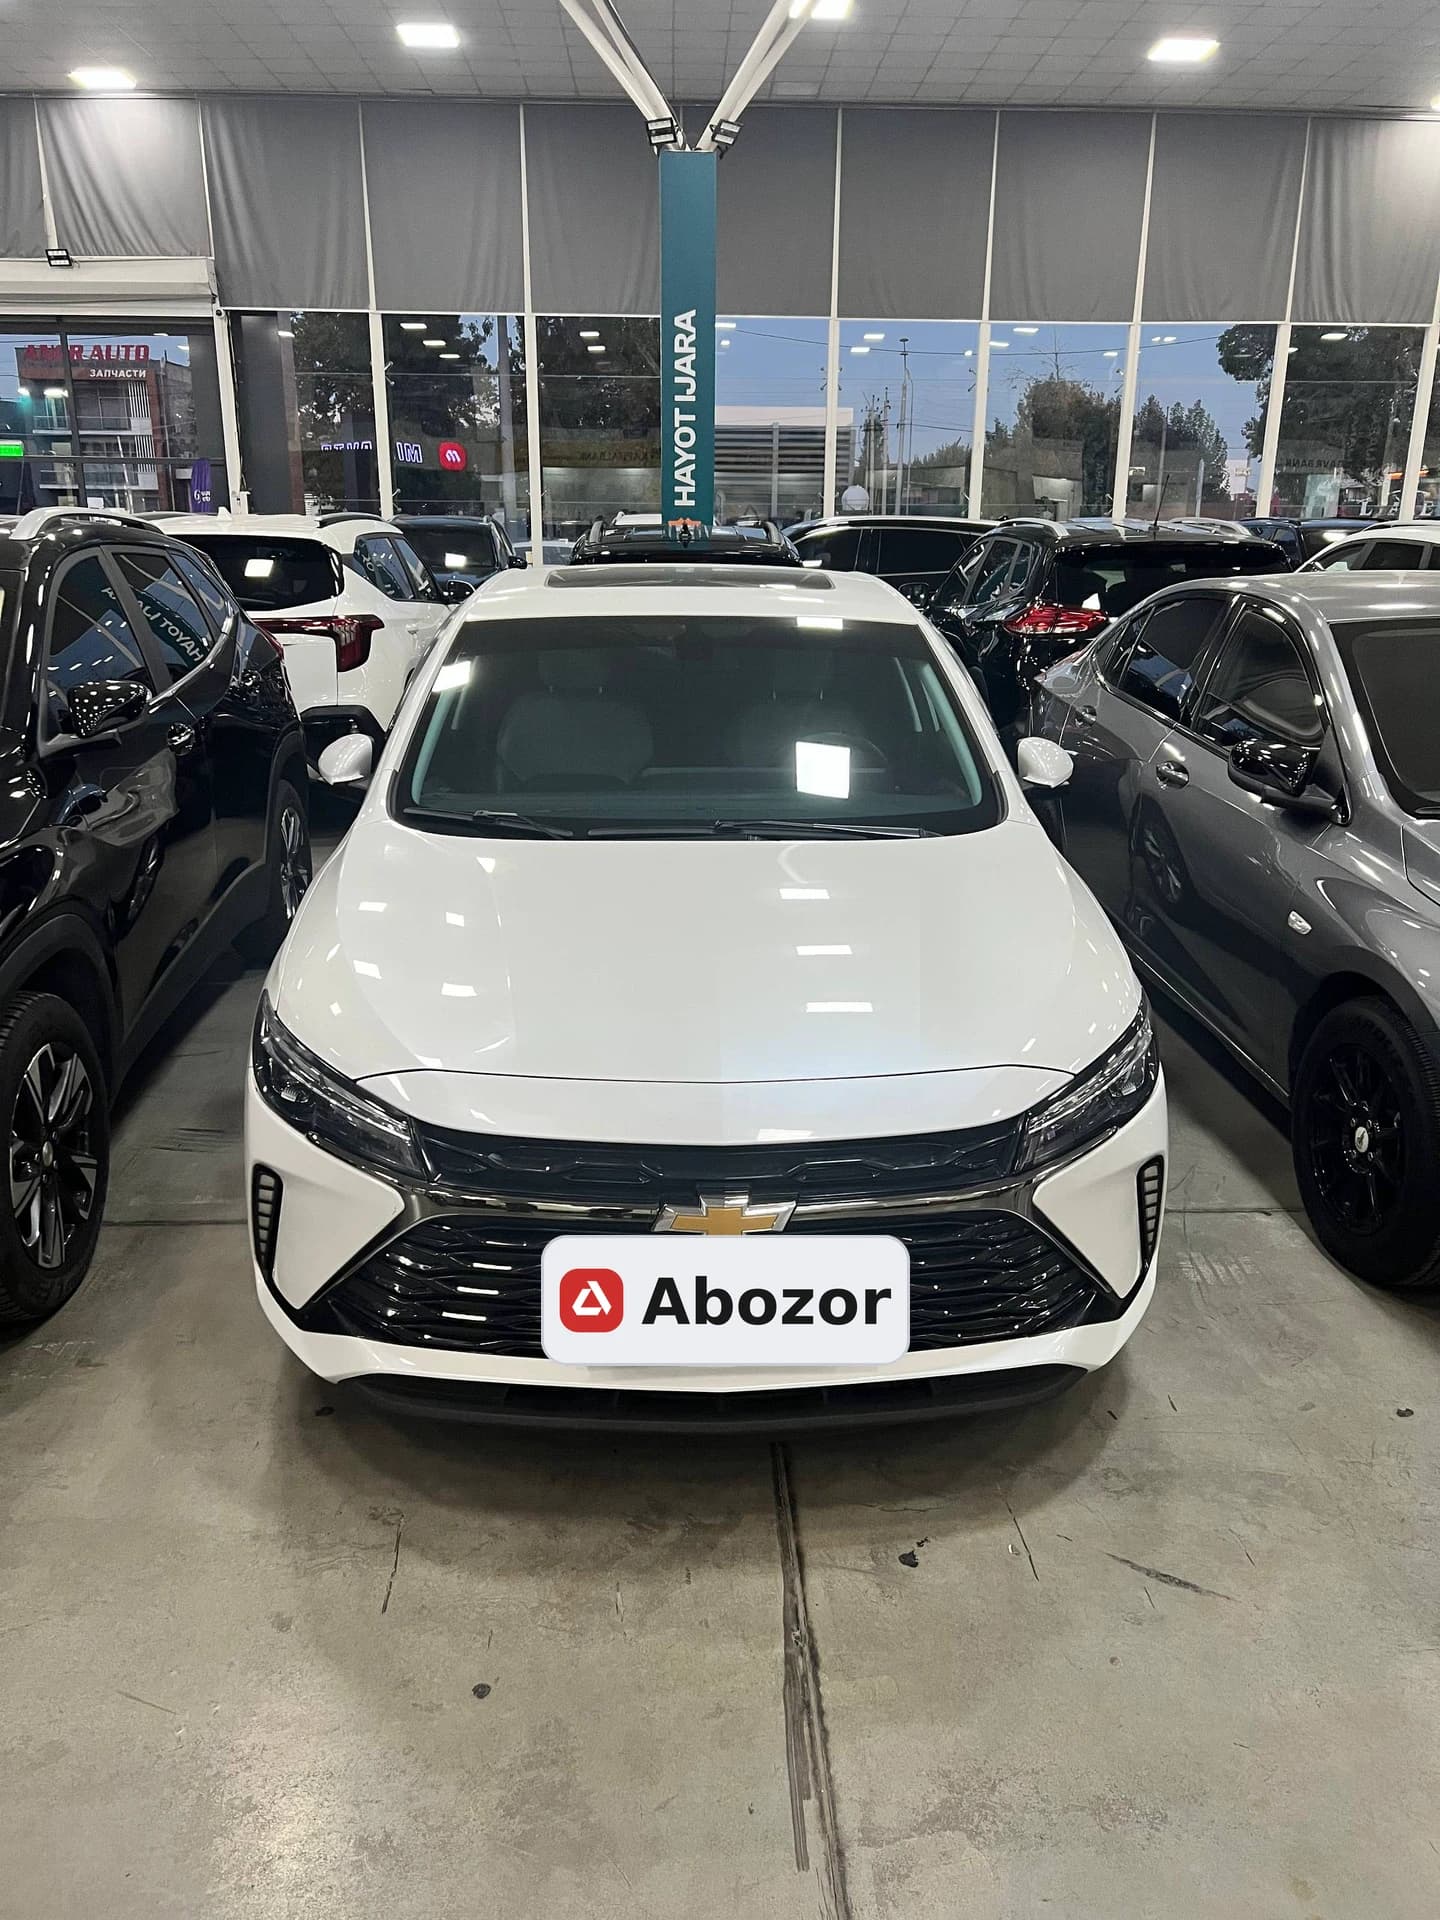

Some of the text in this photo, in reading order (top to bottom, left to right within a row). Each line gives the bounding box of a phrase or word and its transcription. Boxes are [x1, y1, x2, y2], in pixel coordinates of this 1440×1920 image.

[90, 344, 150, 361] AUTO
[89, 369, 147, 378] ЗАПЧАСТИ
[674, 308, 697, 507] HAYOT IJARA
